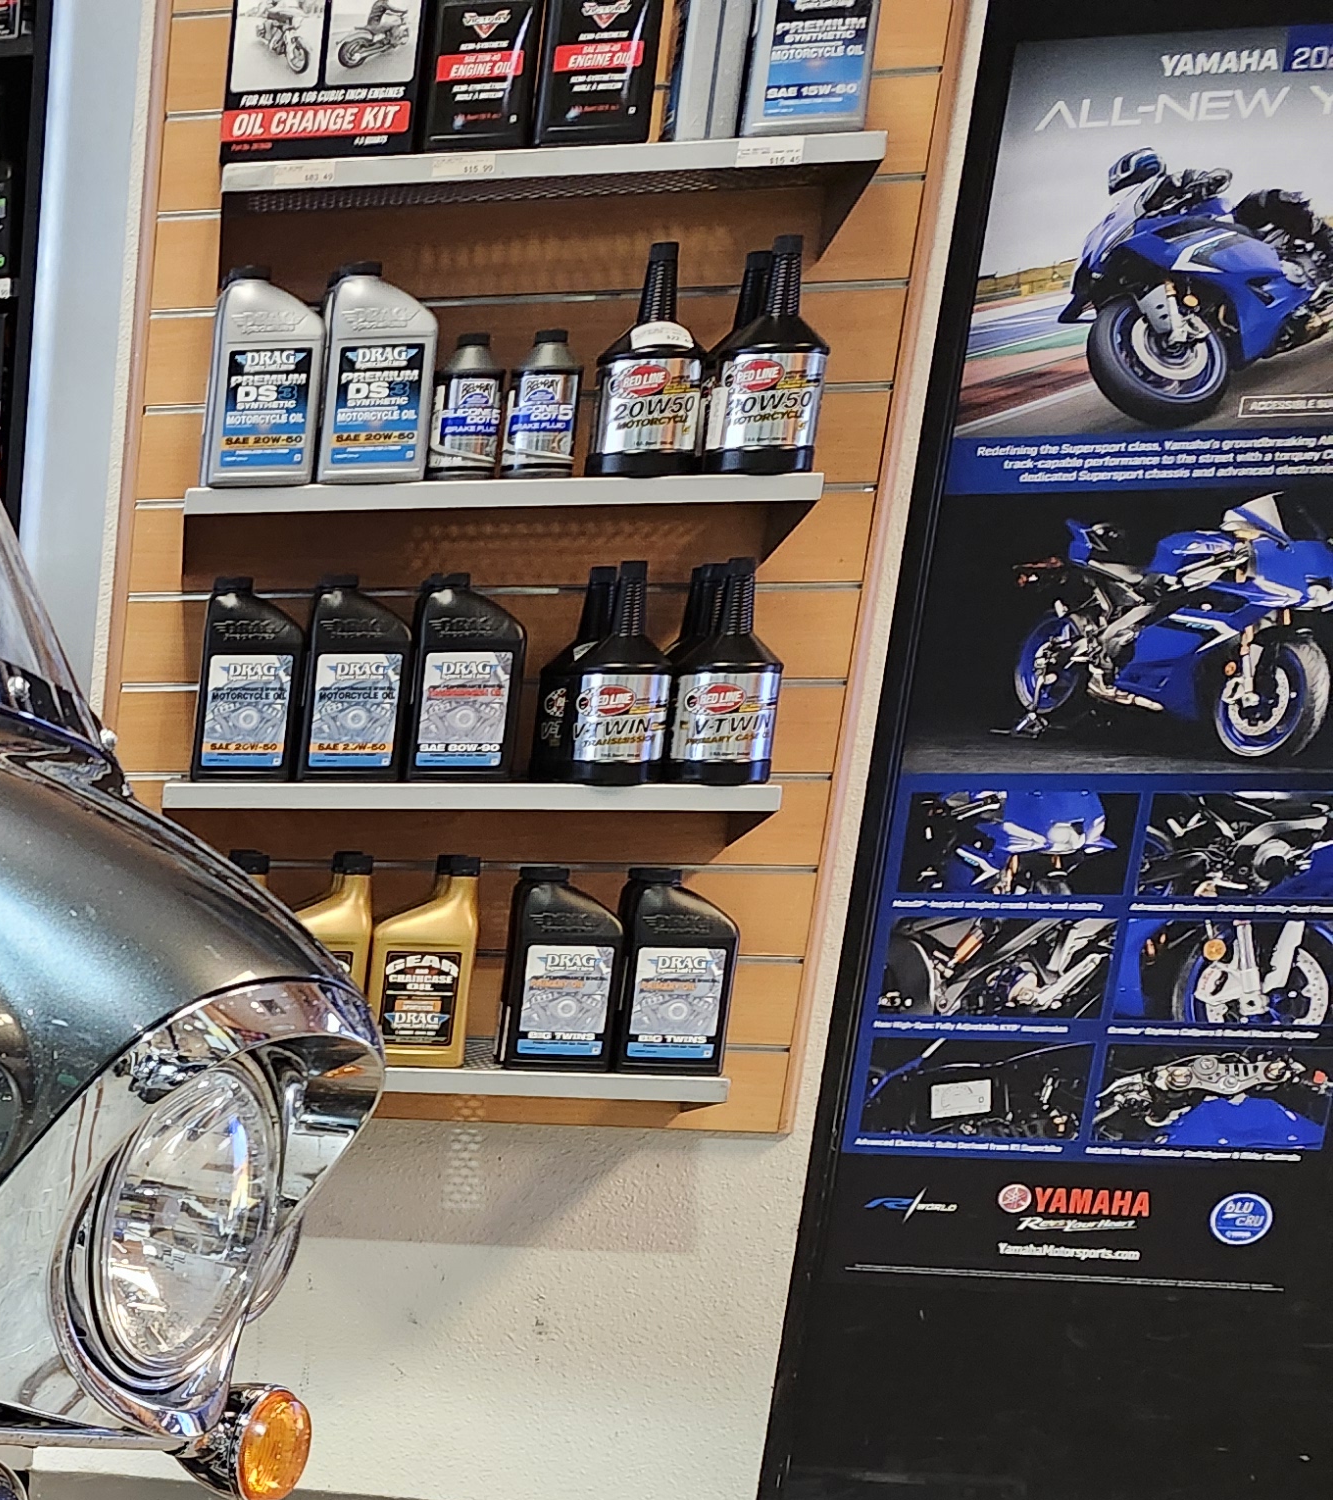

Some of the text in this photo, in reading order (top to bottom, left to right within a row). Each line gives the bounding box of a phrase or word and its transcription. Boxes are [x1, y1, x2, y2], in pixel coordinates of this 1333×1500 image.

[776, 17, 867, 35] PREMIUM
[783, 30, 855, 44] SYNTHETIC
[771, 43, 865, 61] MOTORCYCLE OIL
[568, 52, 633, 69] ENGINE OIL
[1160, 46, 1333, 77] YAMAHA 20
[450, 62, 513, 78] ENGINE OIL
[368, 87, 406, 100] ENGINES
[766, 87, 797, 99] SAE
[1034, 86, 1291, 132] ALL-NEW
[232, 105, 400, 137] OIL CHANGE KIT
[246, 350, 296, 368] DRAG
[356, 347, 409, 364] DRAG
[230, 373, 306, 388] PREMIUM
[341, 370, 419, 385] PREMIUM
[622, 372, 666, 389] RED LINE
[734, 368, 780, 384] RED LINE
[237, 384, 297, 400] DS3
[347, 381, 410, 399] DS3
[236, 399, 296, 410] SYNTHETIC
[613, 397, 695, 420] 20W50
[1250, 400, 1316, 412] ACCESSIBLE
[226, 412, 305, 425] MOTORCYCLE OIL
[337, 410, 417, 424] MOTORCYCLE OIL
[466, 415, 491, 426] DOT
[530, 404, 573, 422] DOT 5
[225, 436, 251, 446] SAE
[335, 433, 361, 444] SAE
[976, 445, 1038, 459] Redefining
[1039, 444, 1058, 456] the
[1060, 441, 1126, 456] Supersport
[1127, 440, 1162, 453] class,
[1163, 438, 1221, 451] Yamaha's
[1221, 435, 1315, 451] groundbreaking
[1003, 456, 1082, 470] track-capable
[1083, 454, 1160, 469] performance
[1162, 454, 1174, 464] to
[1174, 453, 1196, 464] the
[1198, 452, 1234, 463] street
[1236, 451, 1262, 462] with
[1019, 465, 1274, 484] dedicated Supersport chassis and advanced
[229, 663, 276, 677] DRAG
[336, 662, 384, 676] DRAG
[442, 661, 491, 676] DRAG
[700, 691, 742, 704] RED LINE
[572, 718, 651, 739] V-TWIN
[694, 714, 771, 735] V-TWIN
[419, 743, 446, 753] SAE
[385, 955, 459, 976] GEAR
[546, 953, 597, 968] DRAG
[657, 955, 708, 970] DRAG
[389, 974, 454, 984] CHAINCASE
[406, 983, 434, 991] OIL
[394, 1013, 439, 1025] DRAG
[528, 1032, 595, 1041] BIG TWINS
[638, 1034, 707, 1044] BIG TWINS
[1034, 1186, 1150, 1218] YAMAHA
[1063, 1218, 1096, 1231] Your
[1097, 1218, 1137, 1231] Heart
[997, 1242, 1141, 1263] YamahaMotorsports.com
